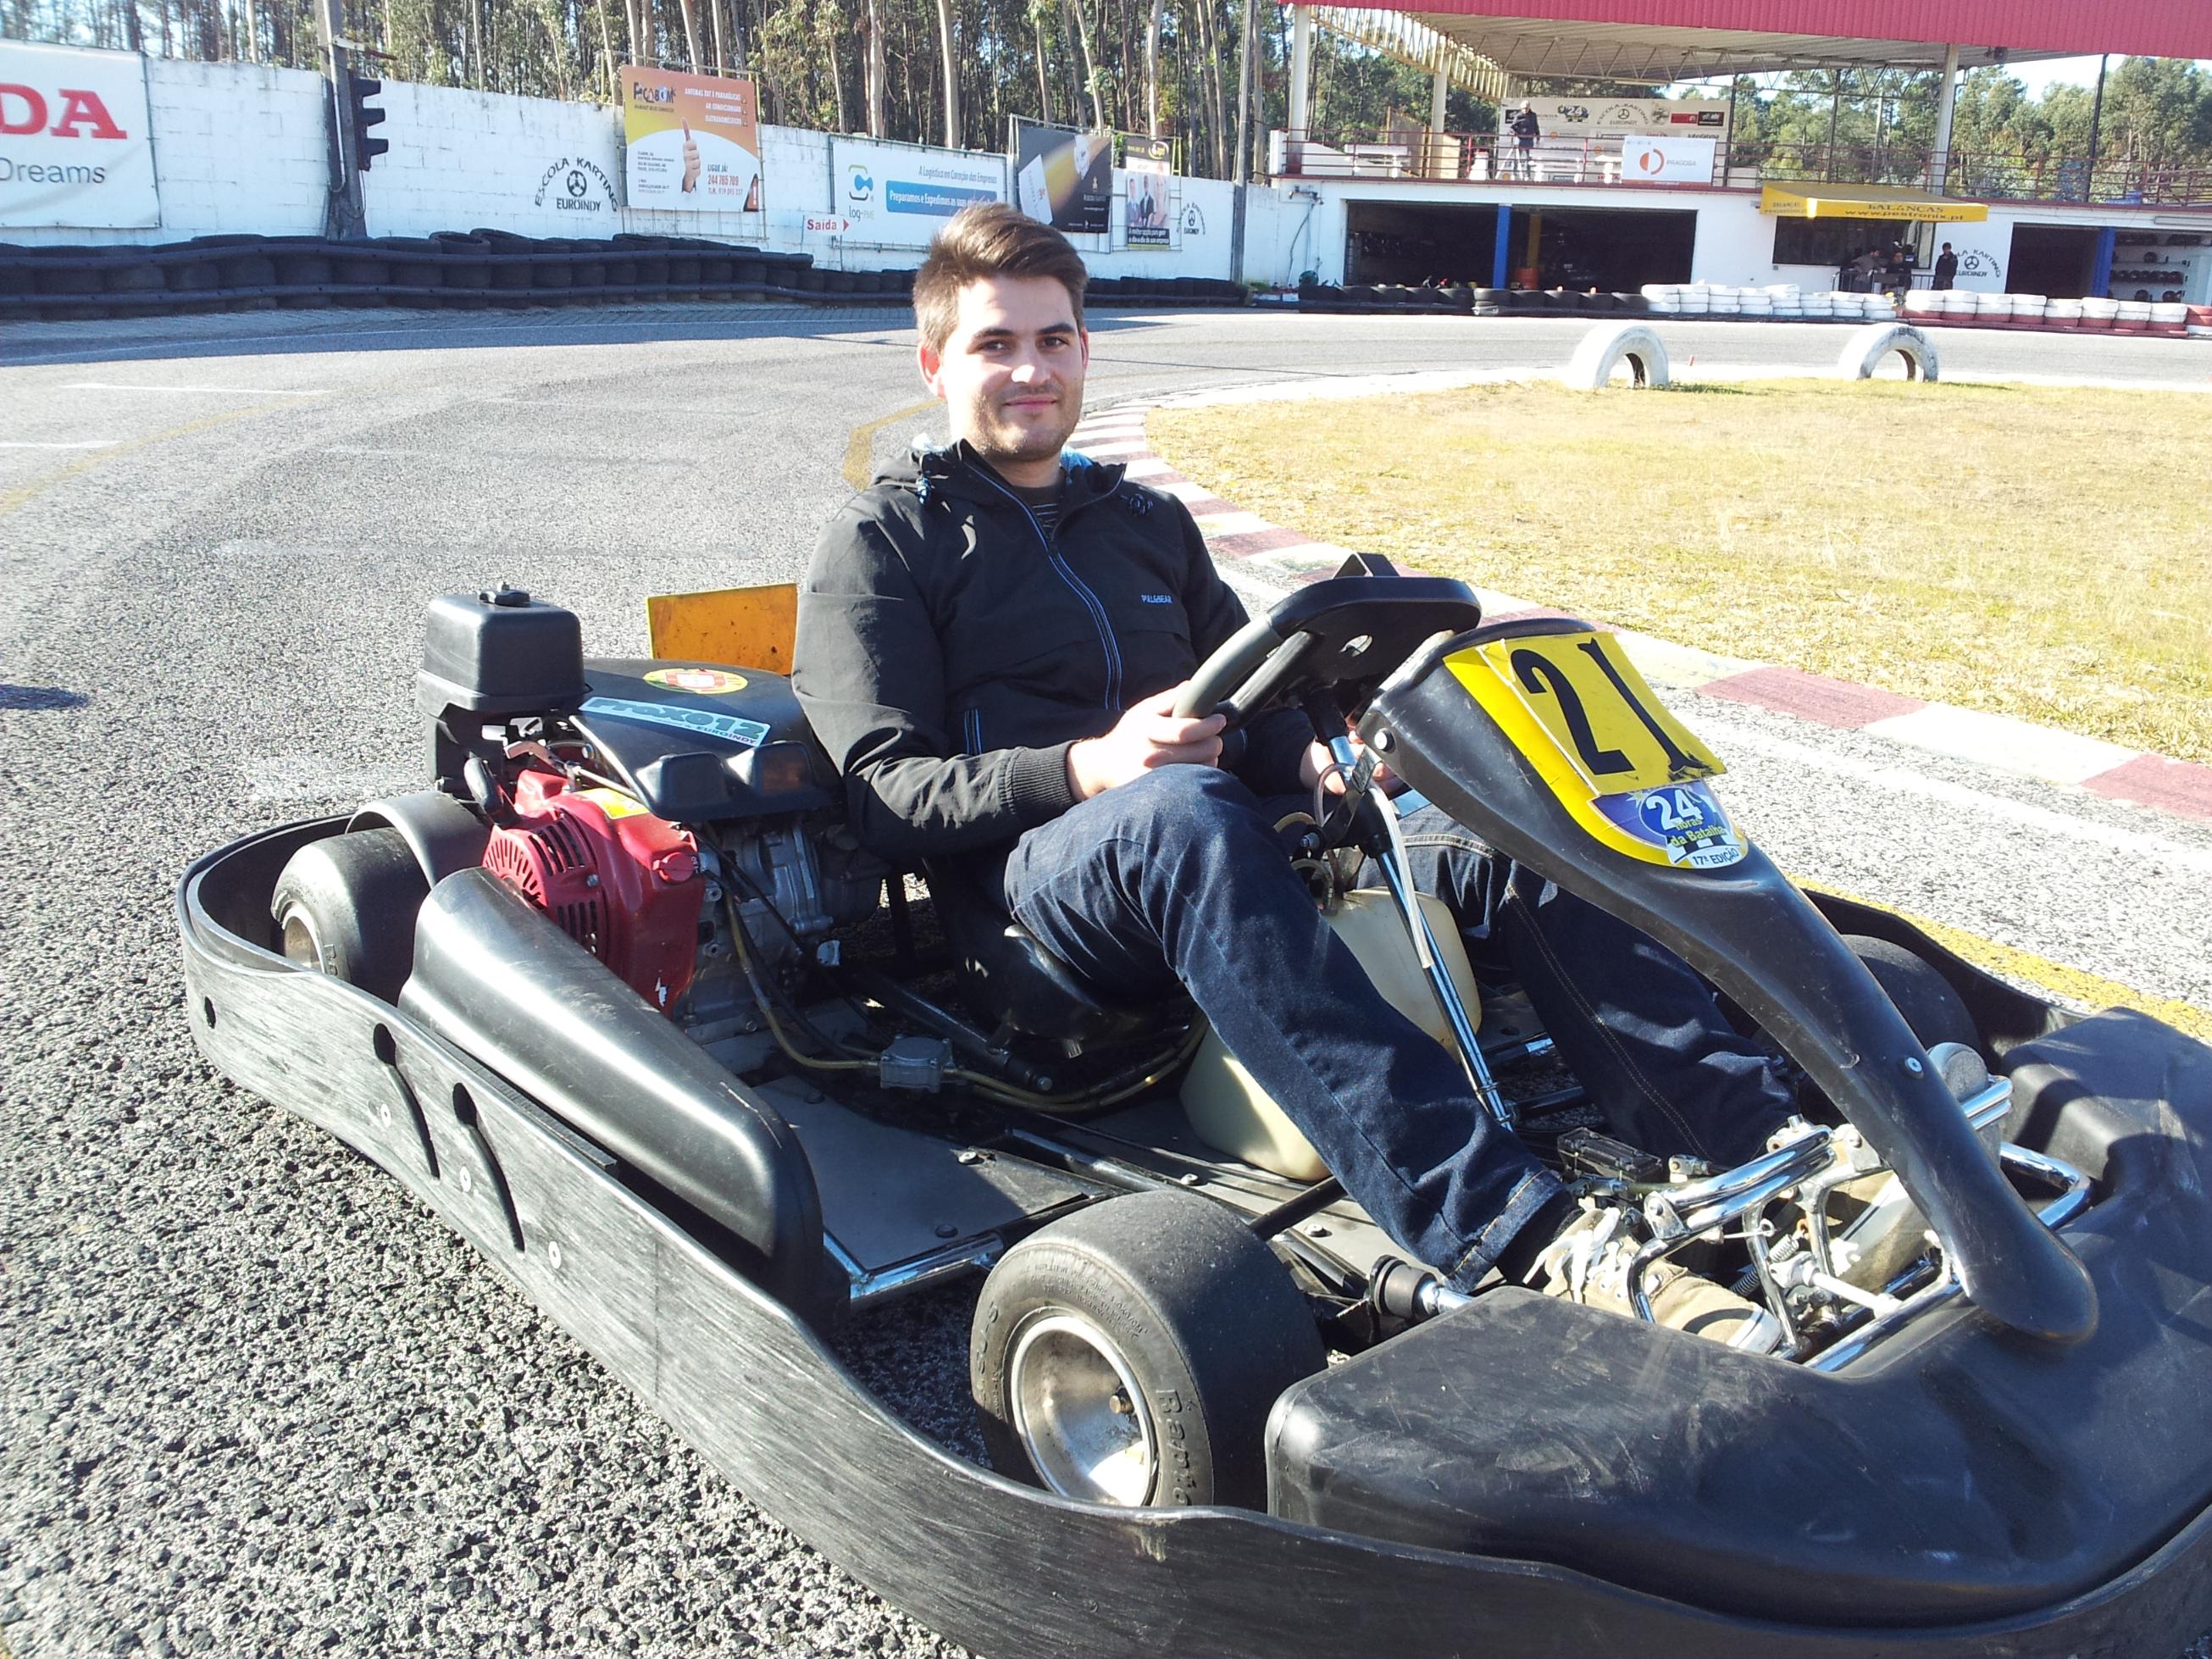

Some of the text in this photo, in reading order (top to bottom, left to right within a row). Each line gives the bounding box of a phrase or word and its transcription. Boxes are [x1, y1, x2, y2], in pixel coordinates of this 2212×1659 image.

[535, 157, 618, 212] ESCOLA KARTING
[557, 197, 601, 211] EUROINDY
[1645, 789, 1704, 830] 24
[1671, 824, 1727, 847] da Batalha
[1711, 847, 1739, 864] EDIÇÃO
